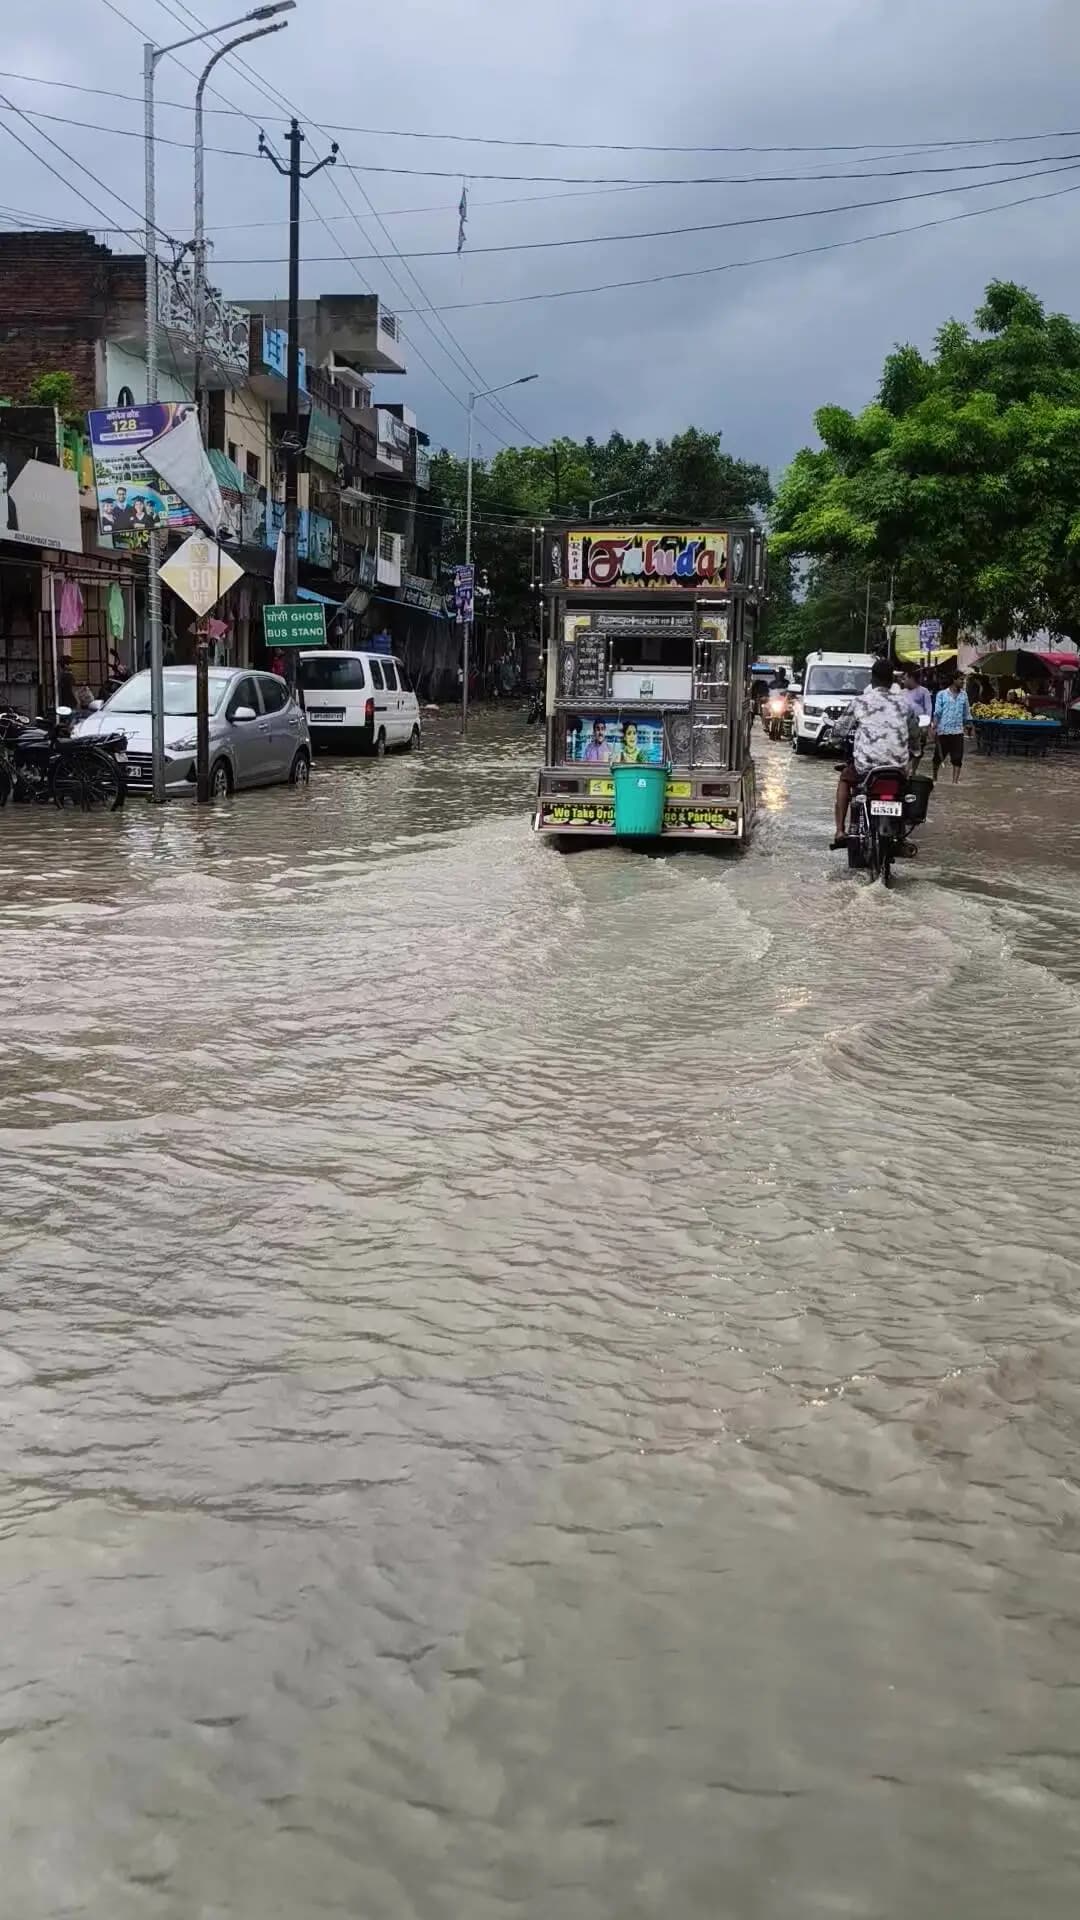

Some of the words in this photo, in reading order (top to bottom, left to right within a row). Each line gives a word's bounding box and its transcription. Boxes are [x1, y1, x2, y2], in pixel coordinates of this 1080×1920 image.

[112, 419, 137, 432] 128
[588, 533, 719, 583] Faluda
[291, 613, 323, 622] GHOSI
[267, 629, 288, 638] BUS
[291, 627, 324, 637] STAND
[554, 807, 570, 818] We
[572, 808, 595, 819] Take
[687, 811, 724, 823] Parties
